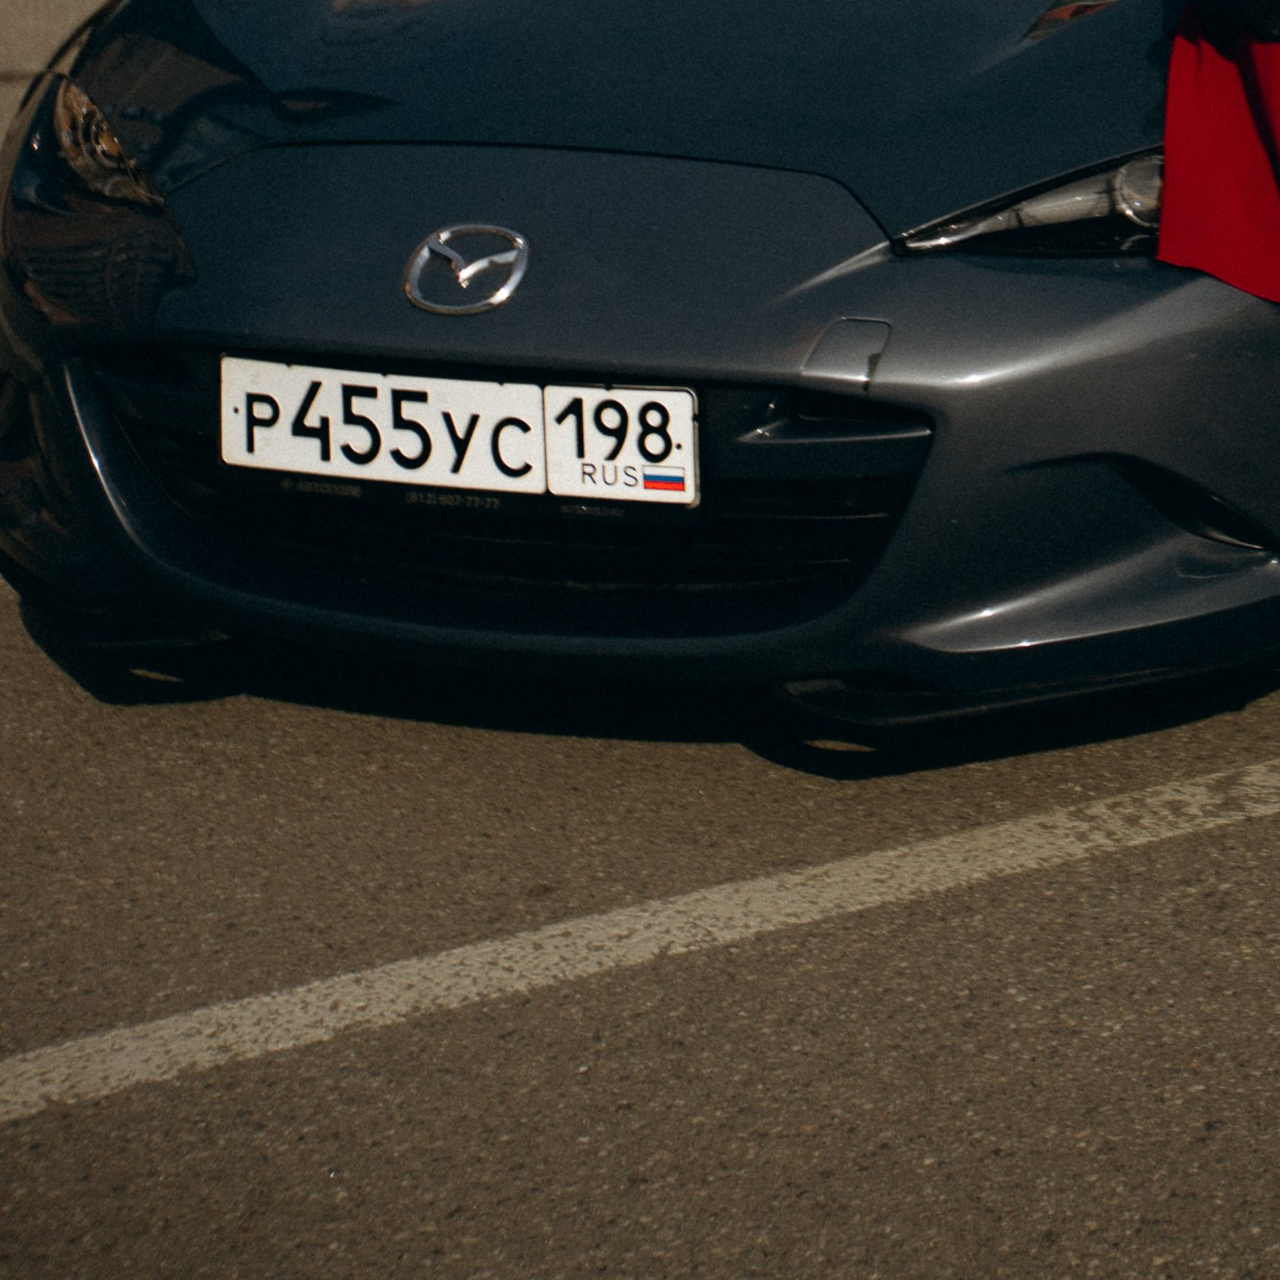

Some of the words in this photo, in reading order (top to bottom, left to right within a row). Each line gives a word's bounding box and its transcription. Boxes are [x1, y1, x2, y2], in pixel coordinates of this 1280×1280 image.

[245, 380, 532, 478] Р455УС
[554, 396, 672, 463] 198
[581, 465, 639, 488] RUS
